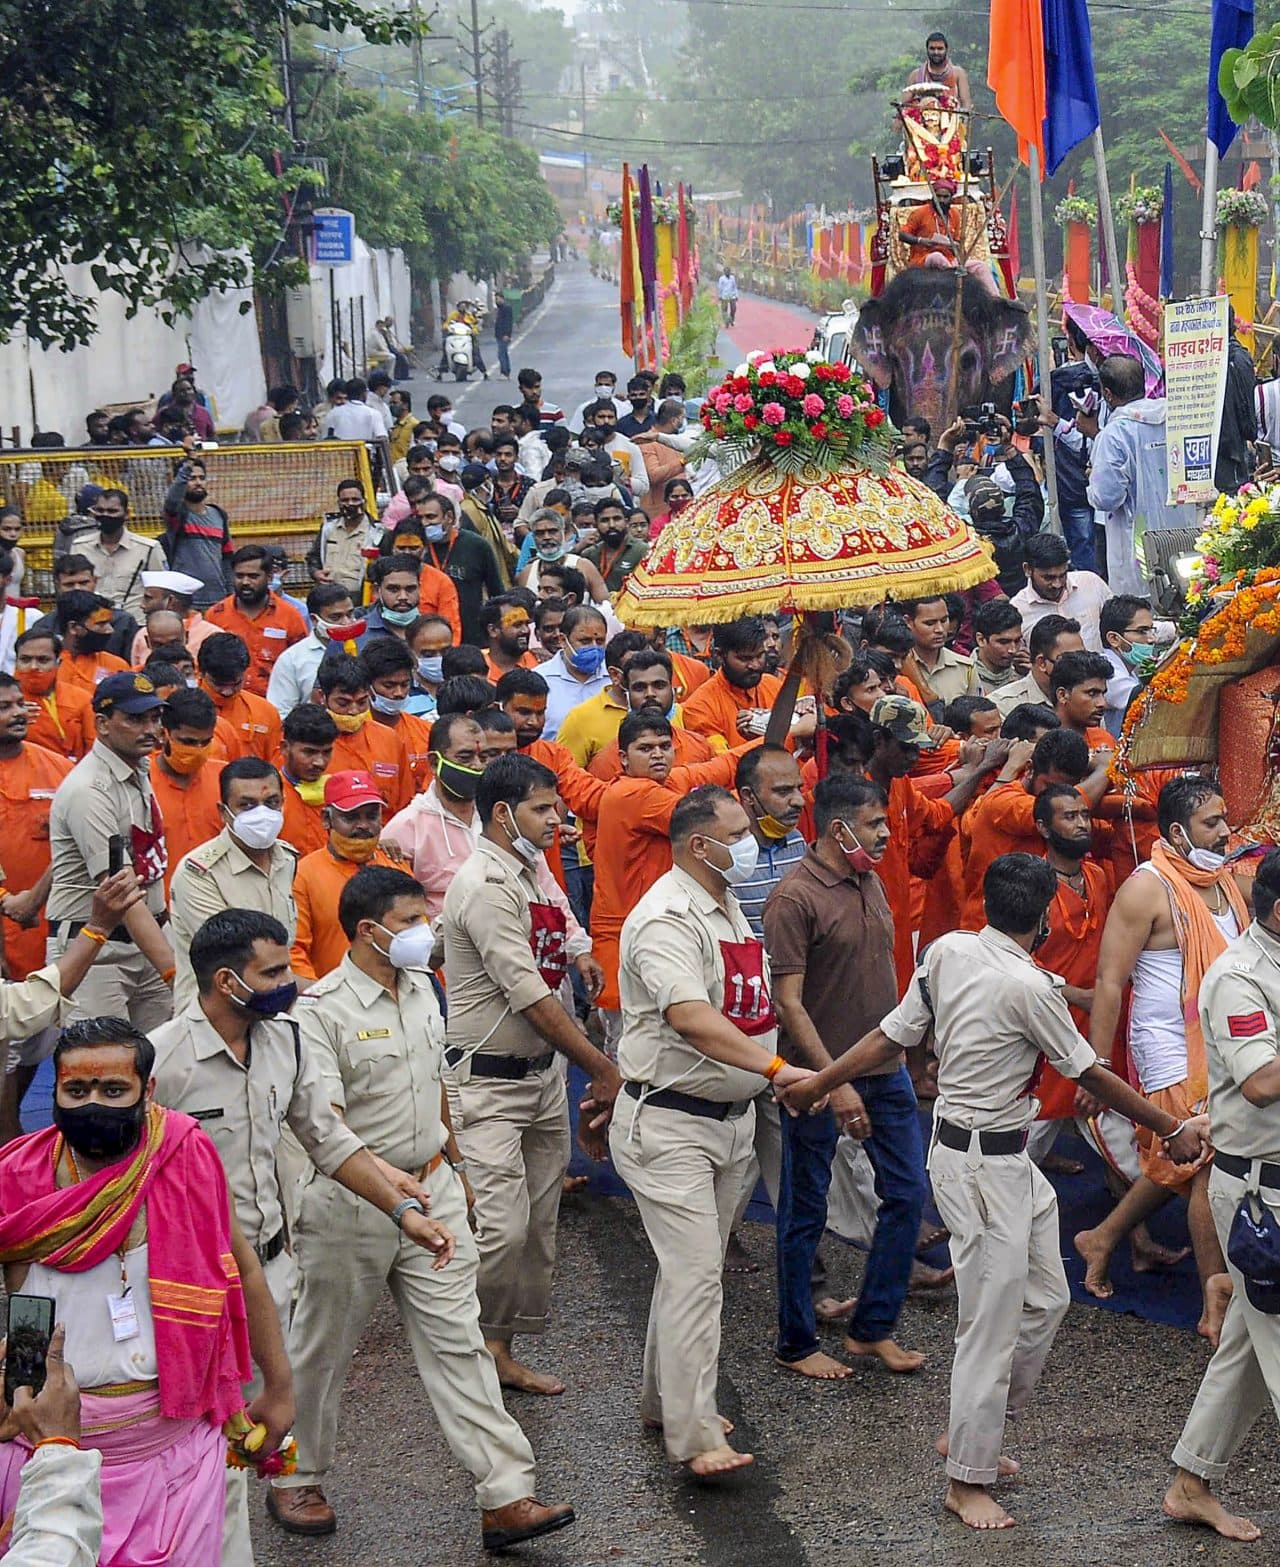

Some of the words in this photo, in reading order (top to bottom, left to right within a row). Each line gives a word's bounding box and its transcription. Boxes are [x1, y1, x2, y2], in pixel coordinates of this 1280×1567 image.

[1168, 340, 1197, 357] लाइव
[1198, 331, 1223, 354] दर्शन
[535, 928, 566, 970] 12
